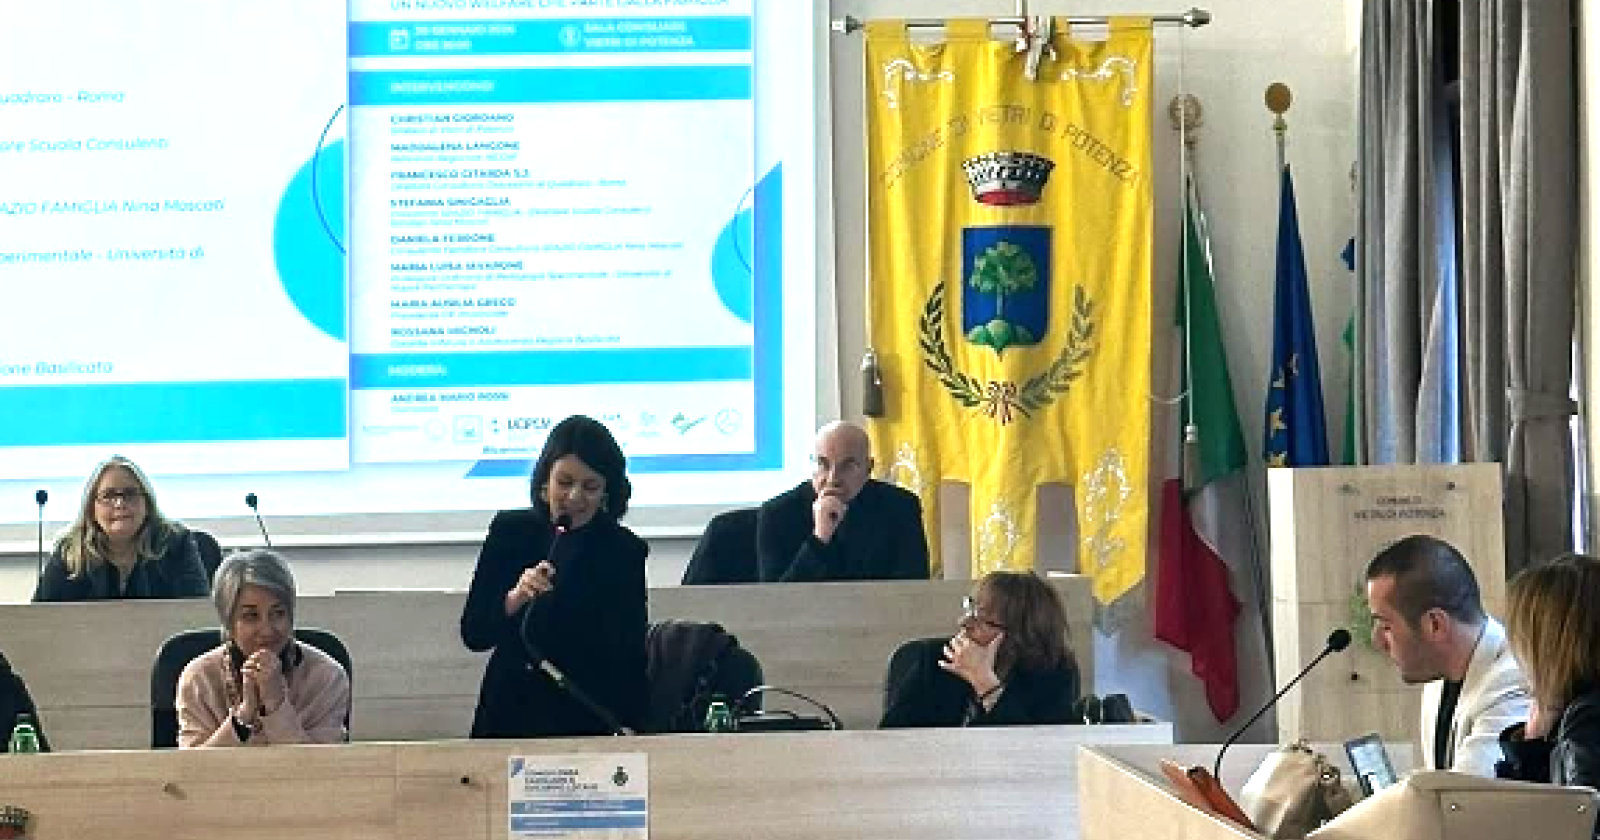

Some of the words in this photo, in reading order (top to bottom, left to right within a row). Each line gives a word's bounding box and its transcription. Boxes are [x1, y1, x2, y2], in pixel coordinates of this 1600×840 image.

[29, 138, 82, 152] Scuola
[86, 136, 170, 151] Consulenti
[41, 199, 118, 214] FAMIGLIA
[122, 199, 160, 212] Nina
[163, 198, 226, 212] Moscati
[35, 360, 114, 375] Basilicata
